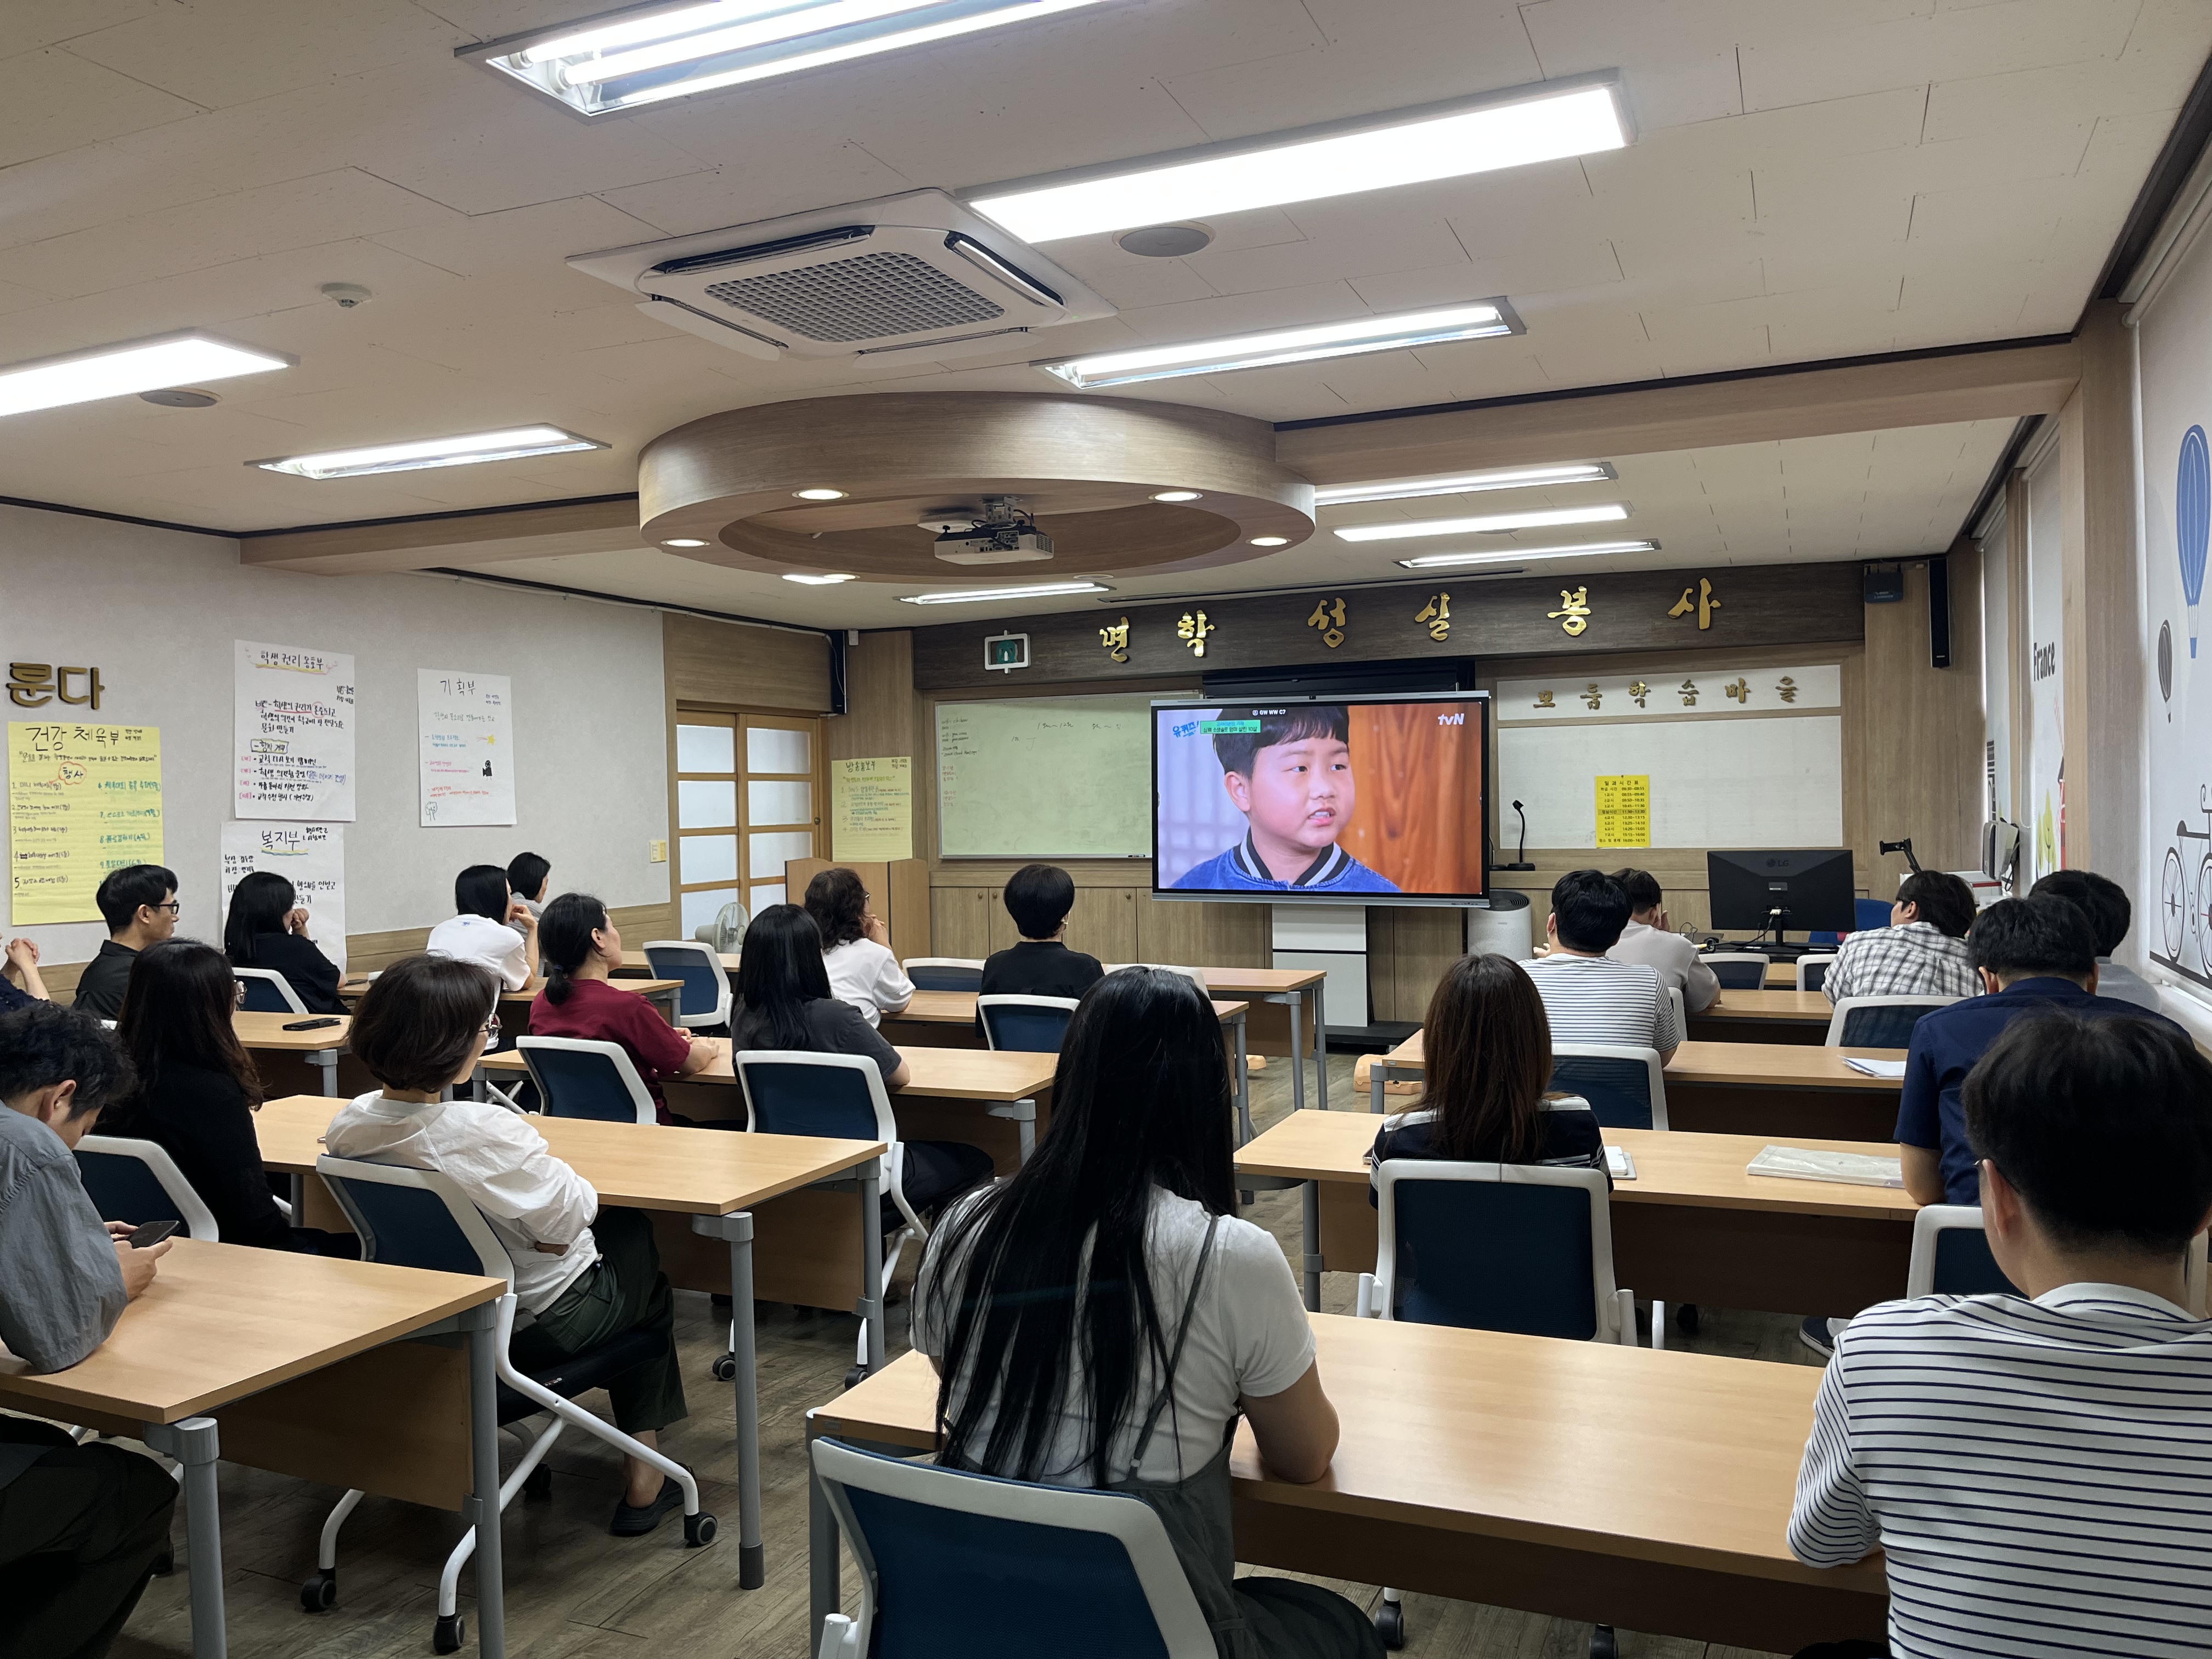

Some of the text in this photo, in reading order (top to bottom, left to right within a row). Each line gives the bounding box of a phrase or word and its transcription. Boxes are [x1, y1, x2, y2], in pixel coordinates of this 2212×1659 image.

[261, 651, 324, 670] 학생 권리 옹호부
[2033, 642, 2055, 681] France
[440, 678, 476, 696] 기획부
[1437, 713, 1465, 725] tvN
[25, 726, 67, 752] 건강
[73, 726, 120, 748] 체육부
[845, 760, 876, 773] 방송홍보부
[262, 830, 301, 851] 복지부
